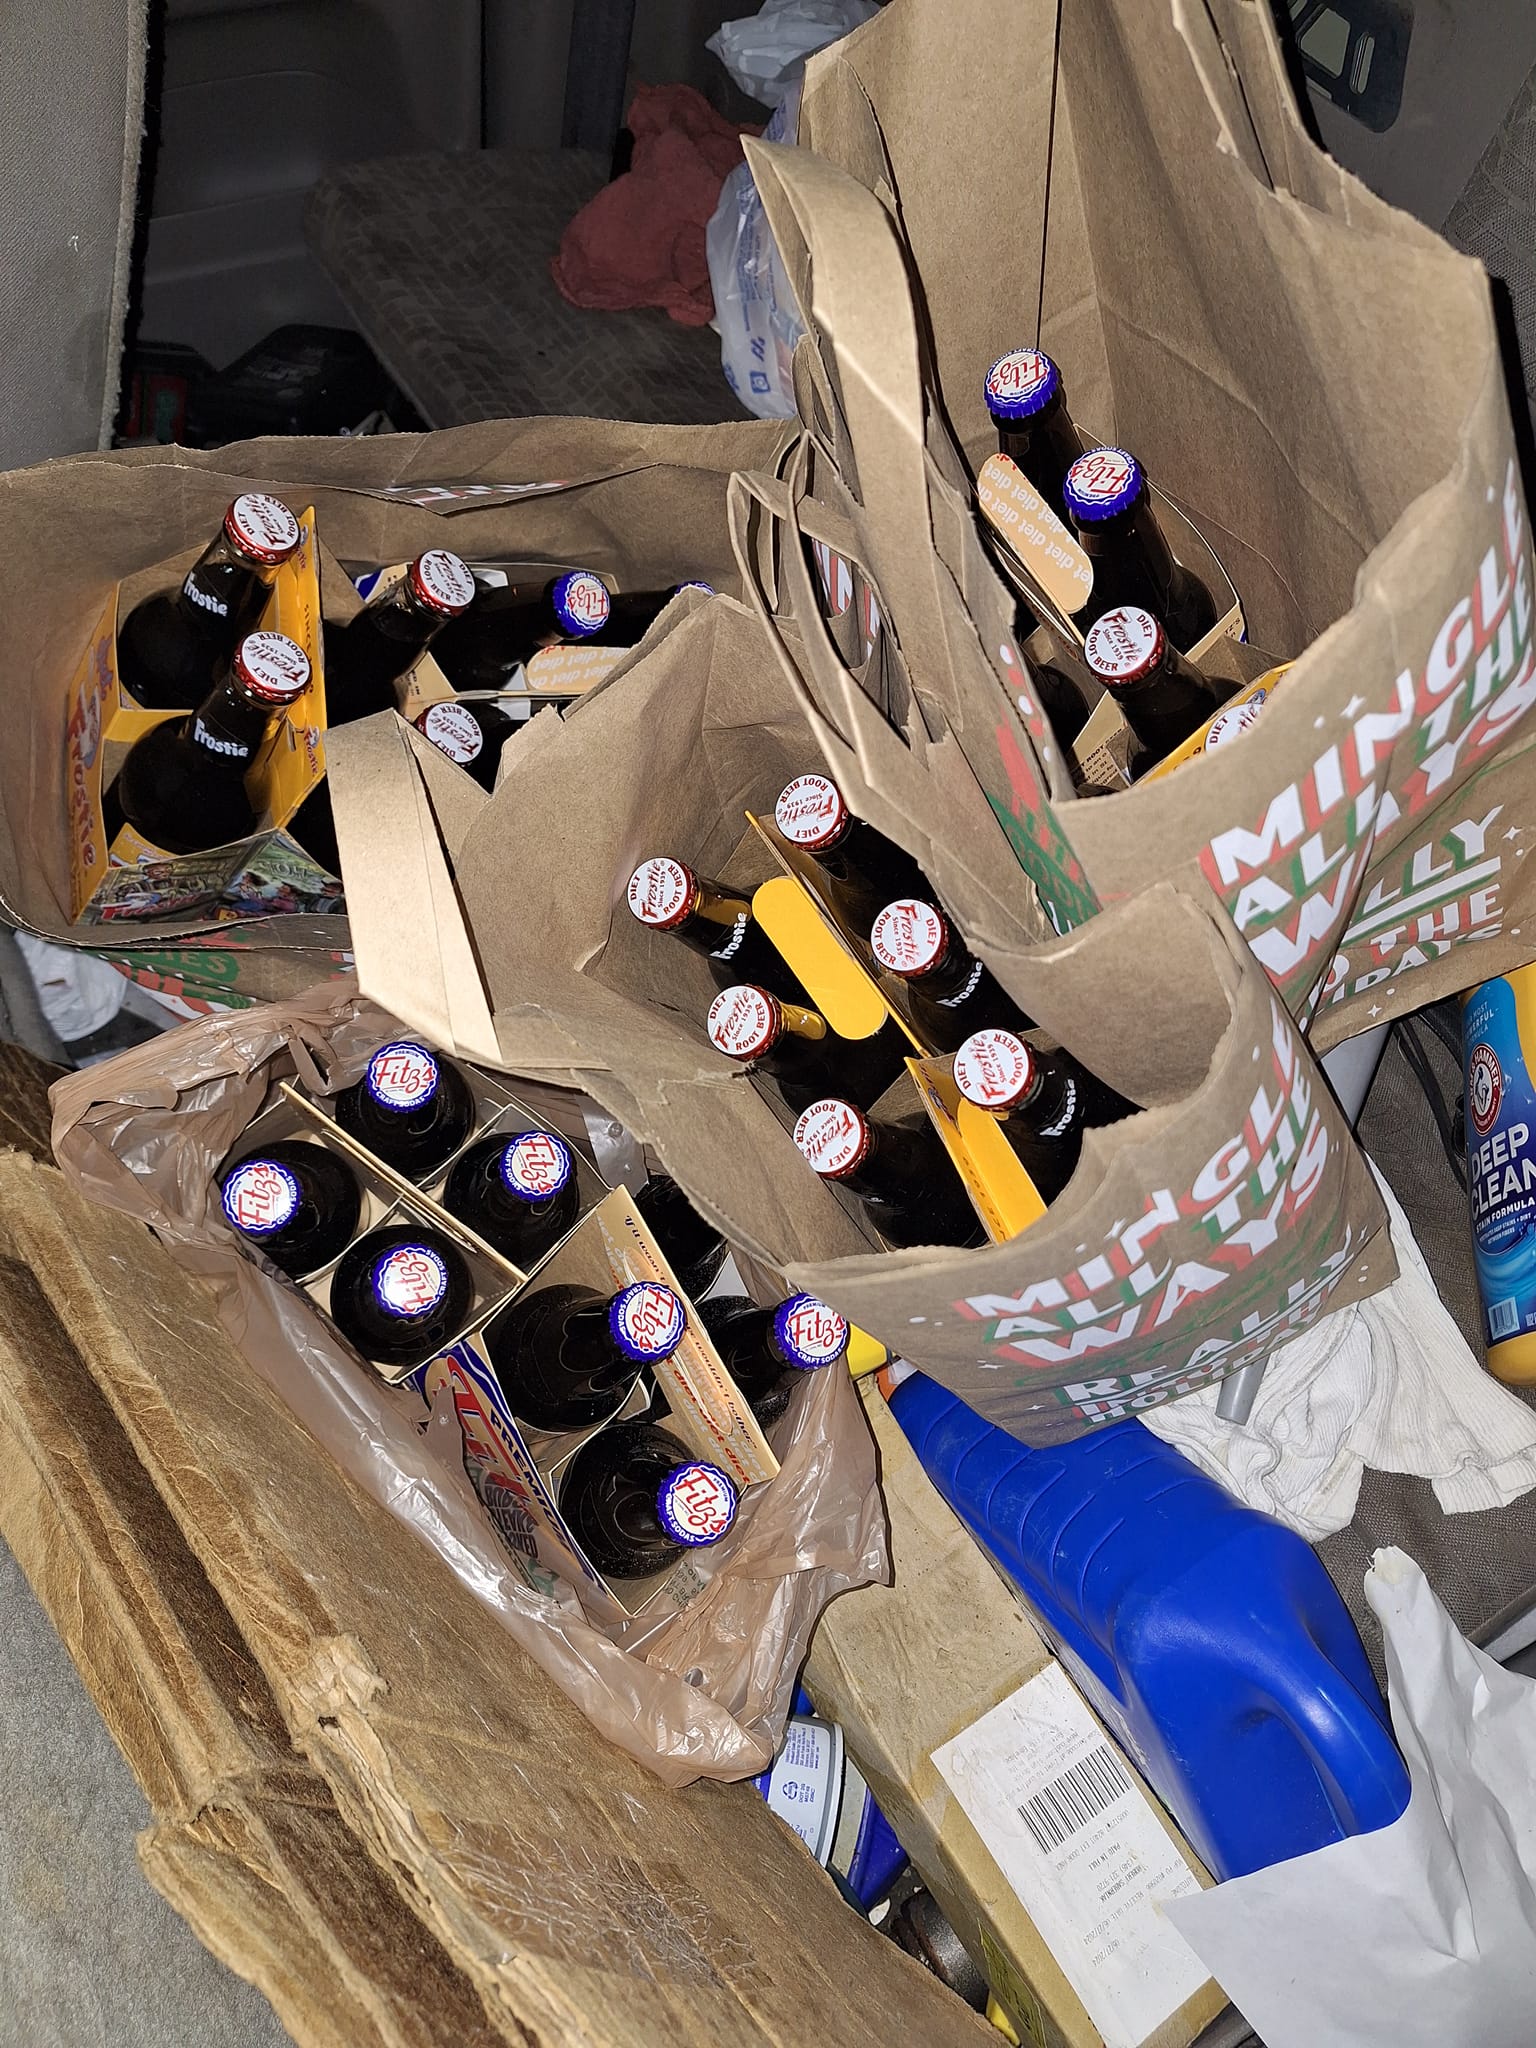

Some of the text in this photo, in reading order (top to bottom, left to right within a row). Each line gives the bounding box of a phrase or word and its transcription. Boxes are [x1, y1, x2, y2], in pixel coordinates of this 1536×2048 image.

[989, 355, 1048, 393] Fitz's
[984, 463, 1012, 488] diet
[1071, 457, 1130, 493] Fitz's
[1011, 485, 1039, 511] diet
[238, 512, 254, 535] DIET
[287, 516, 296, 538] ROOT
[992, 497, 1075, 569] diet diet diet
[183, 572, 228, 617] Frostie
[424, 559, 451, 600] ROOT BEER
[459, 564, 472, 585] DIET
[568, 585, 609, 618] Fitz's
[1103, 611, 1140, 661] Frostie
[1103, 628, 1123, 660] Since 1939
[1137, 614, 1152, 638] DIET
[245, 644, 306, 683] Frostie
[257, 633, 306, 663] ROOT BEER
[1089, 628, 1118, 671] ROOT BEER
[1421, 562, 1533, 751] THE
[253, 667, 278, 685] DIET
[1210, 459, 1525, 885] MINGLE
[193, 718, 249, 758] Frostie
[429, 718, 479, 755] Frostie
[440, 706, 480, 736] ROOT BEER
[1209, 715, 1229, 743] DIET
[779, 794, 833, 823] Frostie
[780, 778, 828, 802] ROOT BEER
[795, 826, 820, 838] DIET
[630, 875, 640, 900] DIET
[641, 860, 660, 919] Frostie
[663, 864, 682, 915] ROOT BEER
[710, 912, 748, 959] Frostie
[874, 912, 896, 964] ROOT BEER
[896, 904, 918, 965] Frostie
[926, 918, 937, 946] DIET
[1370, 883, 1504, 956] THE
[936, 962, 983, 1007] Frostie
[710, 994, 727, 1019] DIET
[714, 989, 749, 1050] Frostie
[732, 1005, 752, 1040] Since 1939
[736, 1003, 765, 1051] ROOT BEER
[375, 1057, 434, 1094] Fitz's
[958, 1061, 972, 1090] DIET
[968, 1038, 1006, 1099] Frostie
[993, 1033, 1024, 1086] ROOT BEER
[1474, 1049, 1499, 1088] HAMMER
[376, 1091, 425, 1107] CRAFT SODAS
[1040, 1079, 1076, 1136] Frostie
[796, 1104, 837, 1143] ROOT BEER
[806, 1115, 836, 1145] Since 1939
[806, 1109, 854, 1162] Frostie
[505, 1145, 520, 1190] CRAFT SODAS
[520, 1136, 556, 1192] Fitz's
[828, 1145, 851, 1167] DIET
[965, 997, 1293, 1317] MINGLE
[1471, 1122, 1530, 1185] DEEP
[239, 1166, 281, 1226] Fitz's
[287, 1176, 297, 1201] SODAS
[994, 1258, 1172, 1338] ALL
[1202, 1056, 1311, 1233] THE
[1471, 1157, 1536, 1222] CLEAN
[1476, 1196, 1536, 1234] STAIN FORMULA
[1010, 1114, 1329, 1362] WAYS
[390, 1252, 433, 1312] Fitz's
[426, 1250, 447, 1295] CRAFT SODAS
[623, 1285, 643, 1304] CRAFT
[632, 1287, 674, 1350] Fitz's
[788, 1309, 845, 1347] Fitz's
[695, 1341, 730, 1398] wouldn't
[797, 1348, 842, 1363] CRAFT SODAS
[673, 1369, 697, 1404] diet
[724, 1447, 750, 1484] diet
[683, 1399, 708, 1433] diet
[707, 1437, 734, 1472] diet
[490, 1408, 573, 1555] PREMIUM
[676, 1469, 727, 1533] Fitz's
[666, 1494, 695, 1541] CRAFT SODAS
